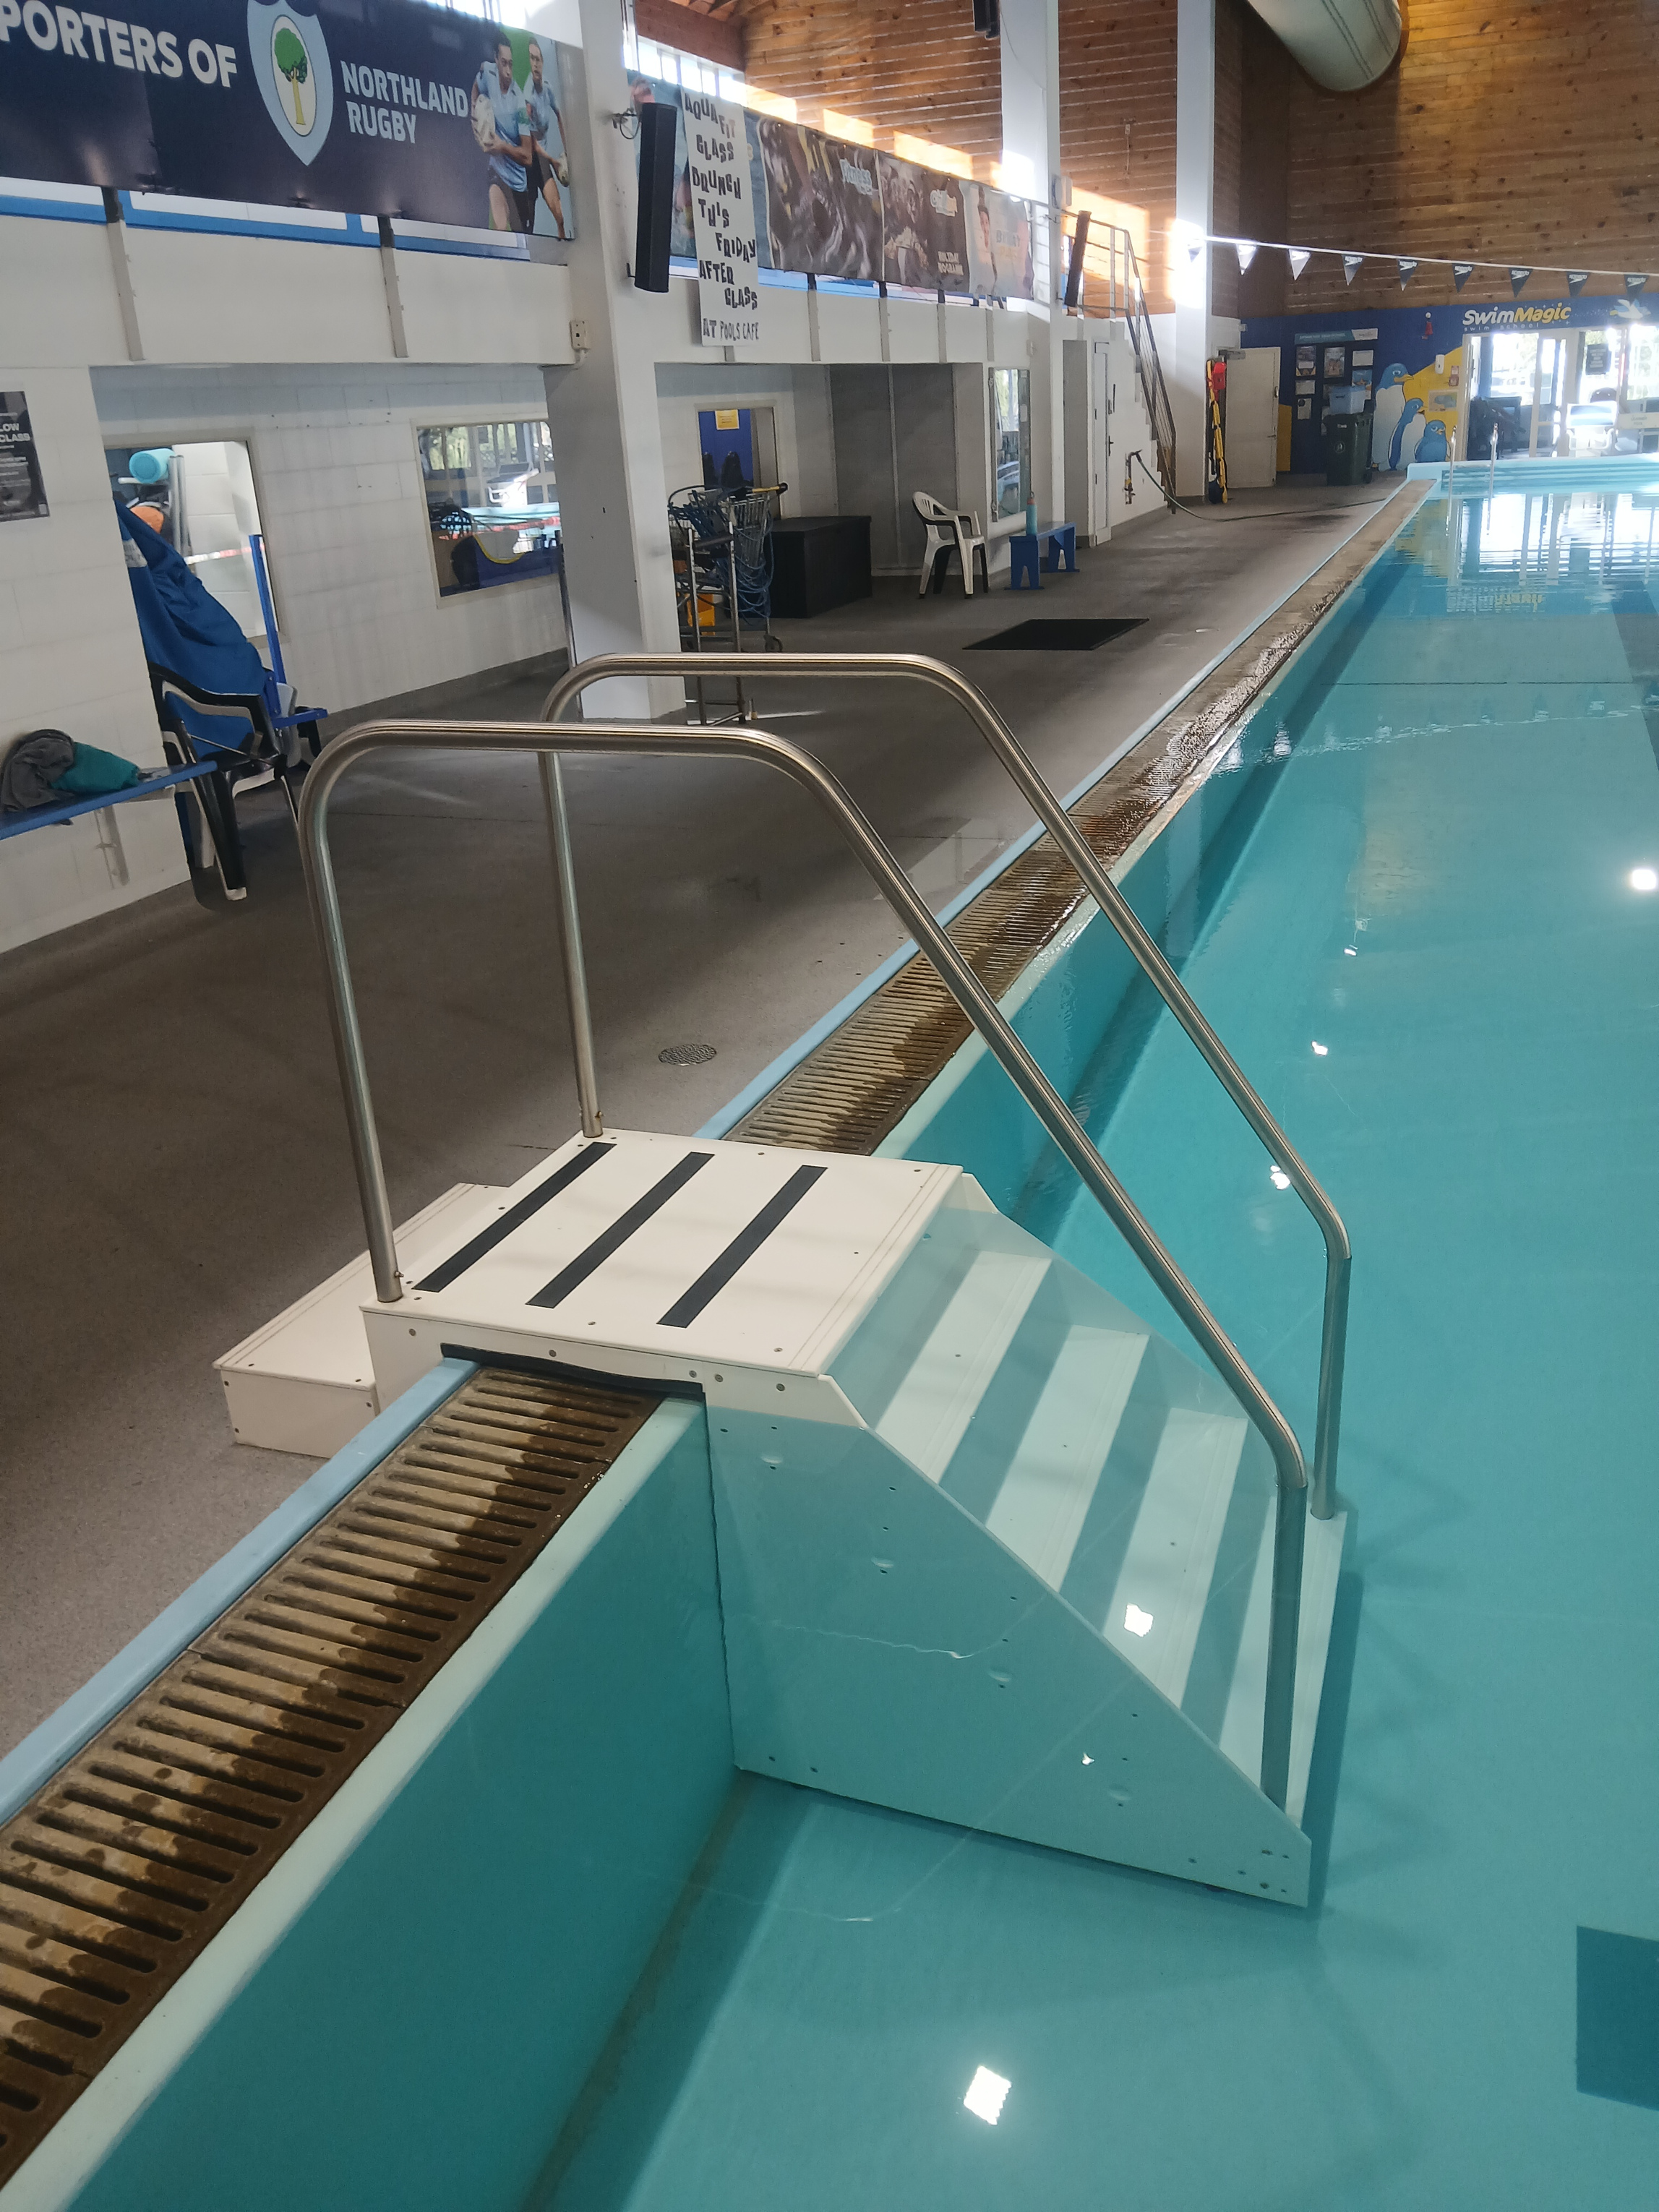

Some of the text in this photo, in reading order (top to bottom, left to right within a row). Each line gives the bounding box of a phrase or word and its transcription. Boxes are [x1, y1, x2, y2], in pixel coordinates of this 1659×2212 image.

[188, 38, 238, 88] OF
[340, 60, 468, 118] NORTHLAND
[346, 100, 416, 144] RUGBY
[696, 134, 734, 163] CLASS
[692, 166, 741, 200] BRUNCH
[698, 198, 729, 228] THIS
[715, 232, 756, 263] FRIDAY
[699, 260, 735, 285] AFTER
[724, 286, 758, 310] CLASS
[1462, 302, 1572, 325] SwimMagic
[703, 318, 717, 338] AT
[719, 320, 741, 341] POOLS
